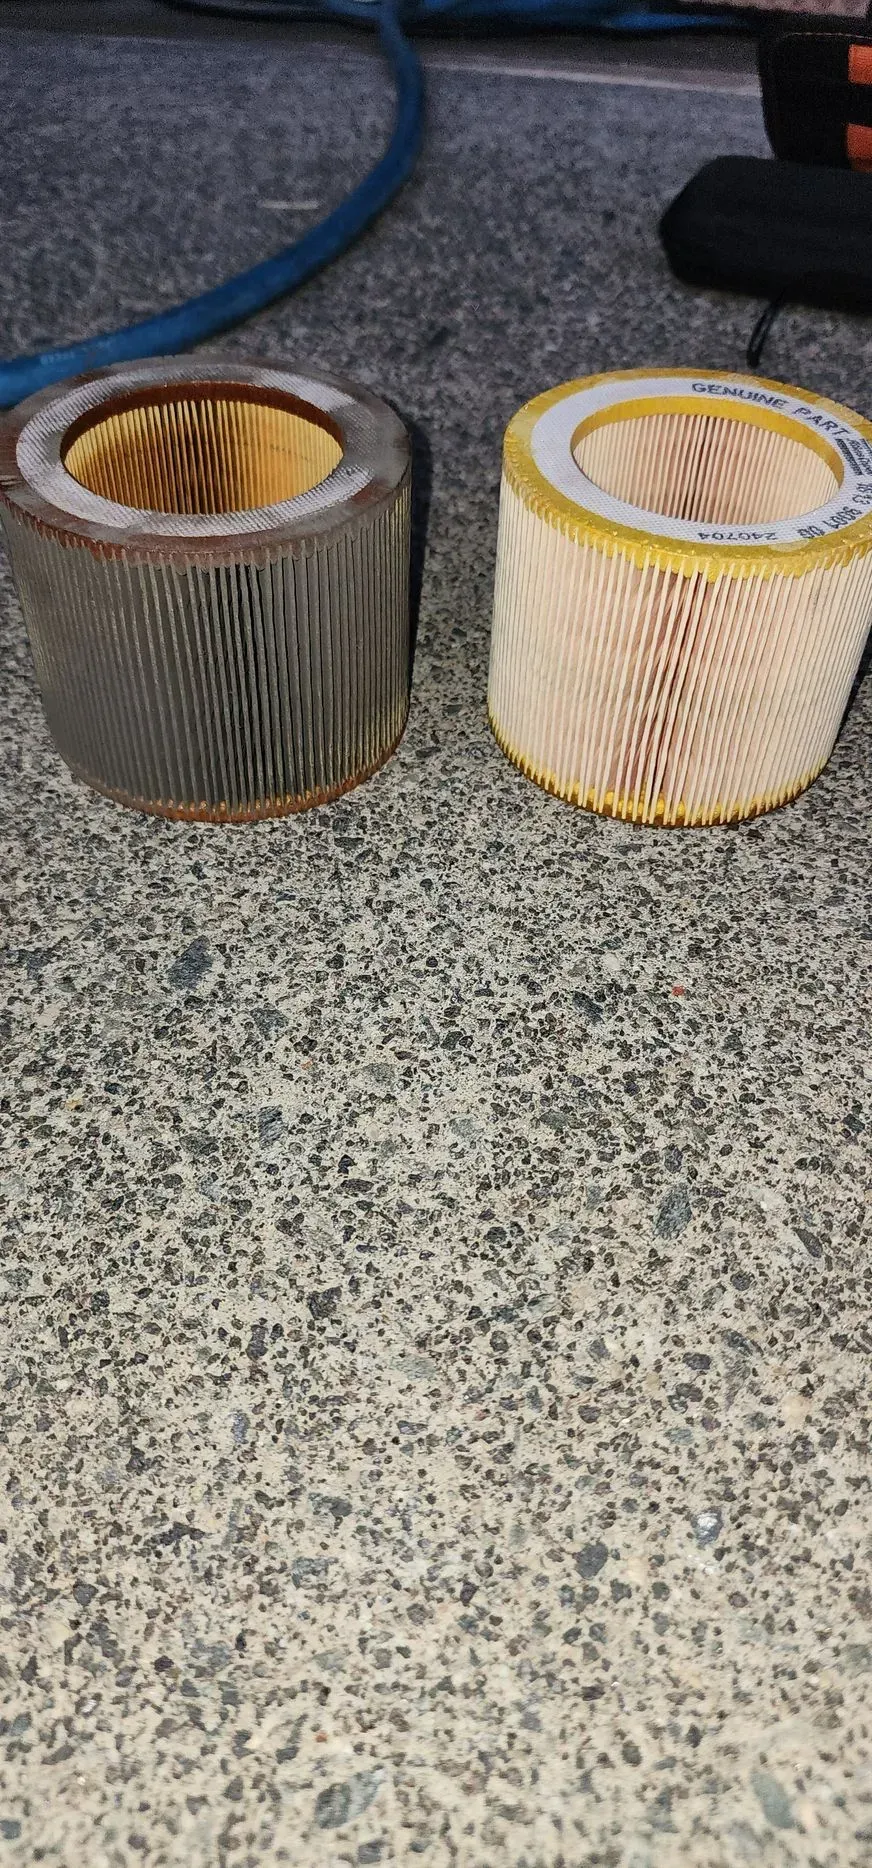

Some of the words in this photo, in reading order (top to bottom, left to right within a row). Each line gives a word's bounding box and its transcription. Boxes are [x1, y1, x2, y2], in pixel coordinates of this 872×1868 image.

[692, 383, 789, 409] GENUINE
[793, 407, 851, 435] PART
[698, 532, 777, 541] 240704
